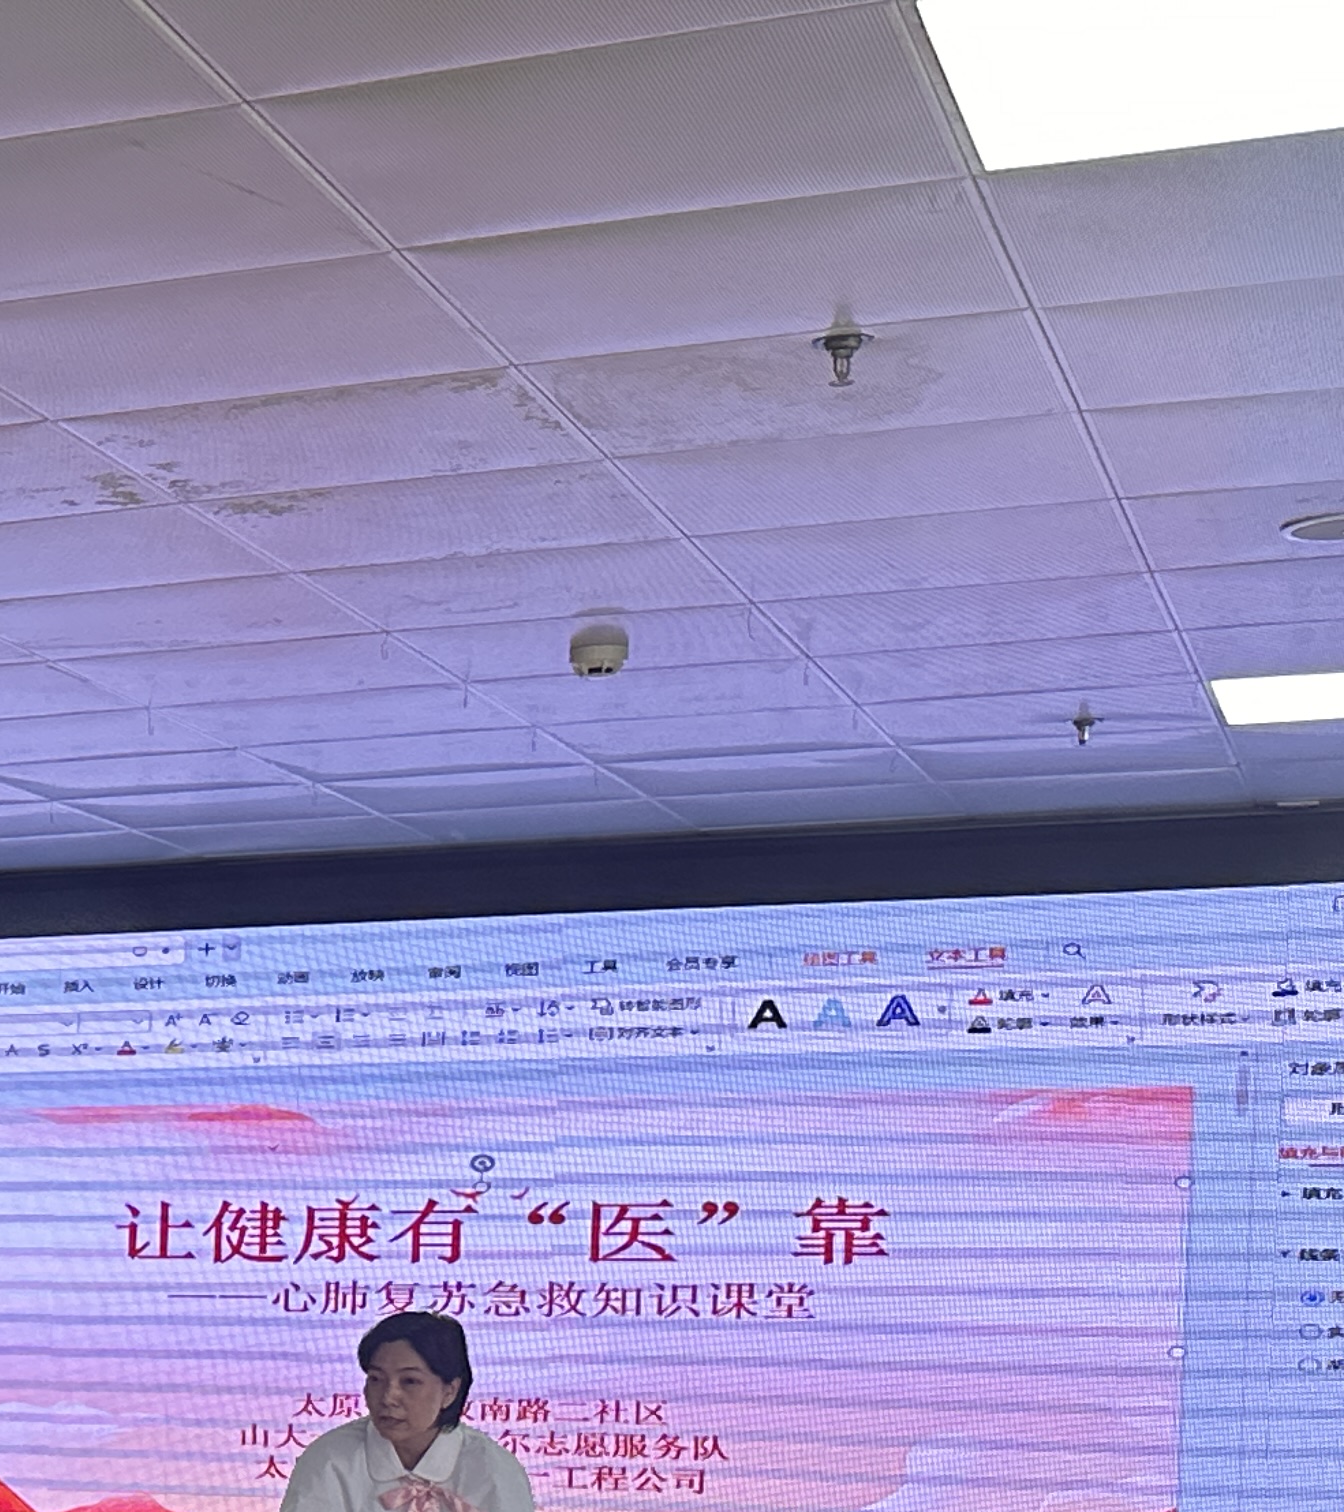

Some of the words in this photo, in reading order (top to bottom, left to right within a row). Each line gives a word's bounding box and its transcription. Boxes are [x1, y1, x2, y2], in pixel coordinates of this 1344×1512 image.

[583, 958, 618, 974] 工具
[133, 976, 164, 990] 设计
[205, 973, 237, 988] 切换
[277, 970, 310, 985] 动画
[64, 980, 94, 994] 插入
[747, 999, 788, 1029] A
[812, 999, 852, 1027] A
[876, 994, 921, 1027] A
